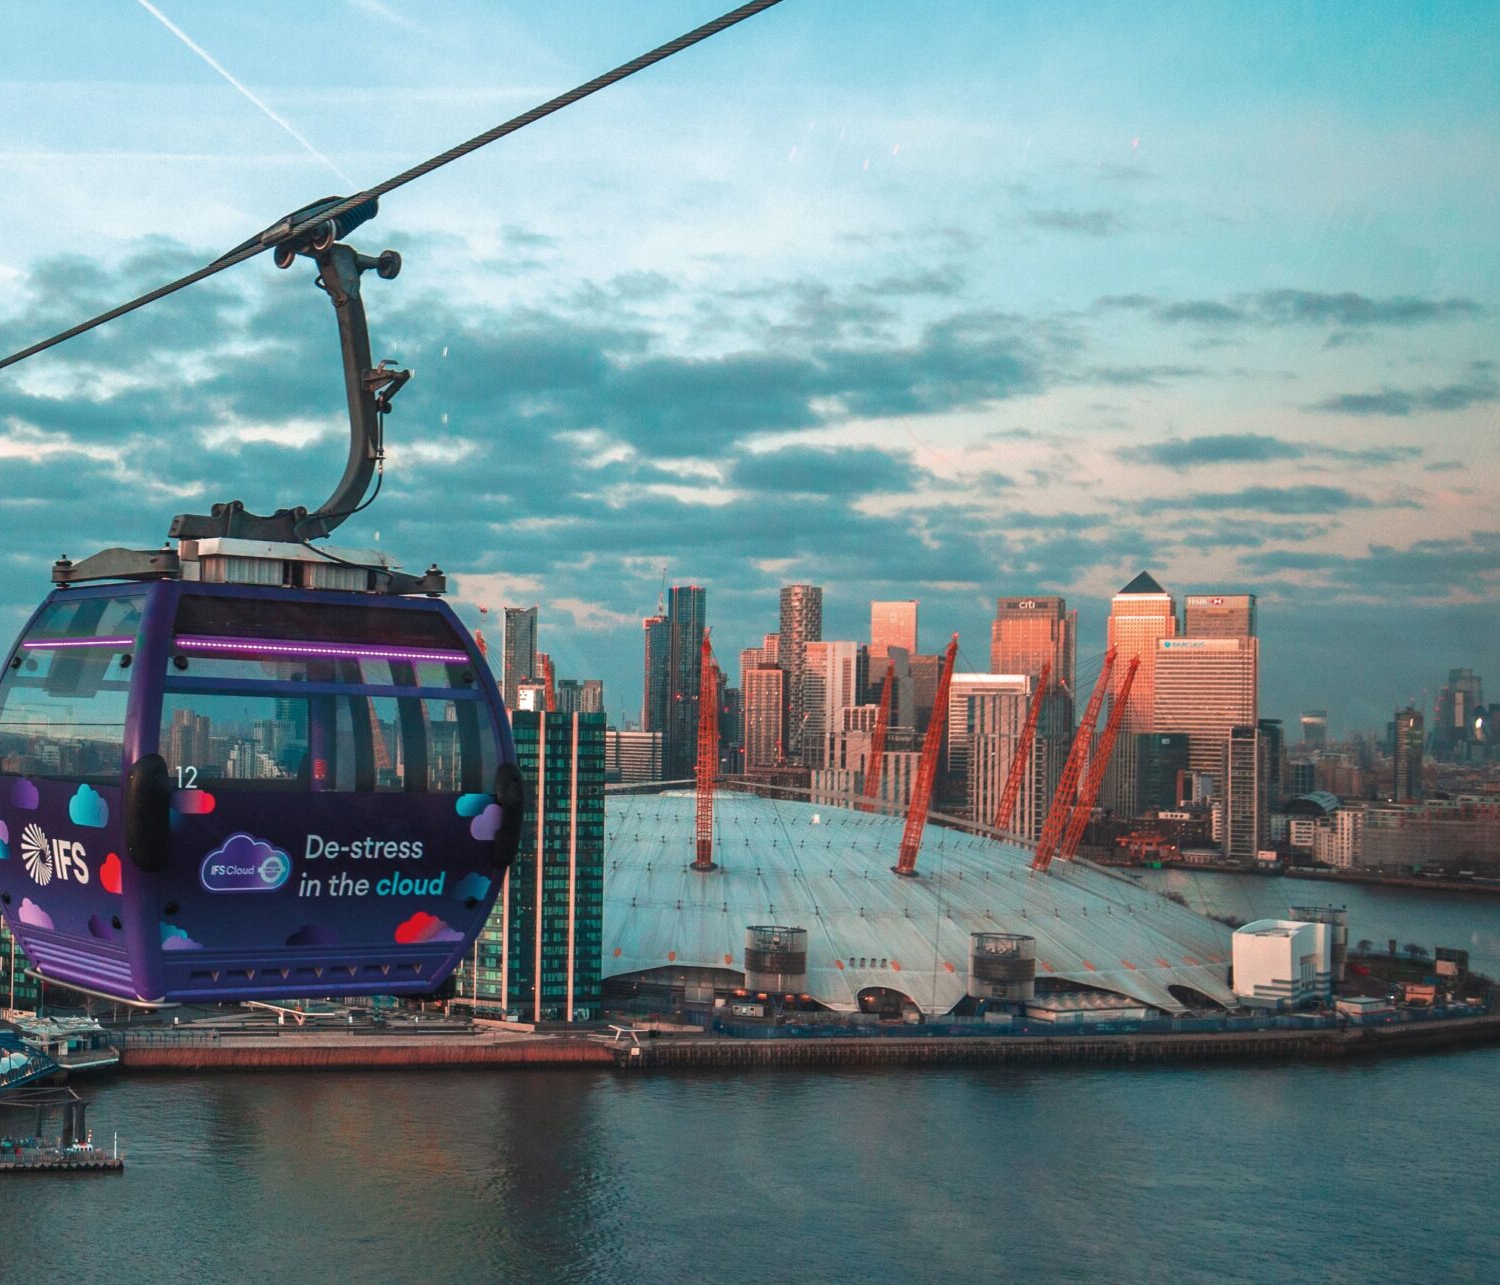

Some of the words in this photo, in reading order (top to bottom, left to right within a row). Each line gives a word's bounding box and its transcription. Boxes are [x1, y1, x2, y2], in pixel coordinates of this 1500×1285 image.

[1018, 600, 1035, 609] citi
[175, 765, 198, 789] 12
[304, 834, 424, 859] De-stress
[52, 838, 90, 885] IFS
[211, 865, 226, 875] IFS
[226, 864, 255, 875] Cloud
[298, 872, 322, 897] in
[328, 871, 371, 897] the
[375, 871, 446, 896] cloud
